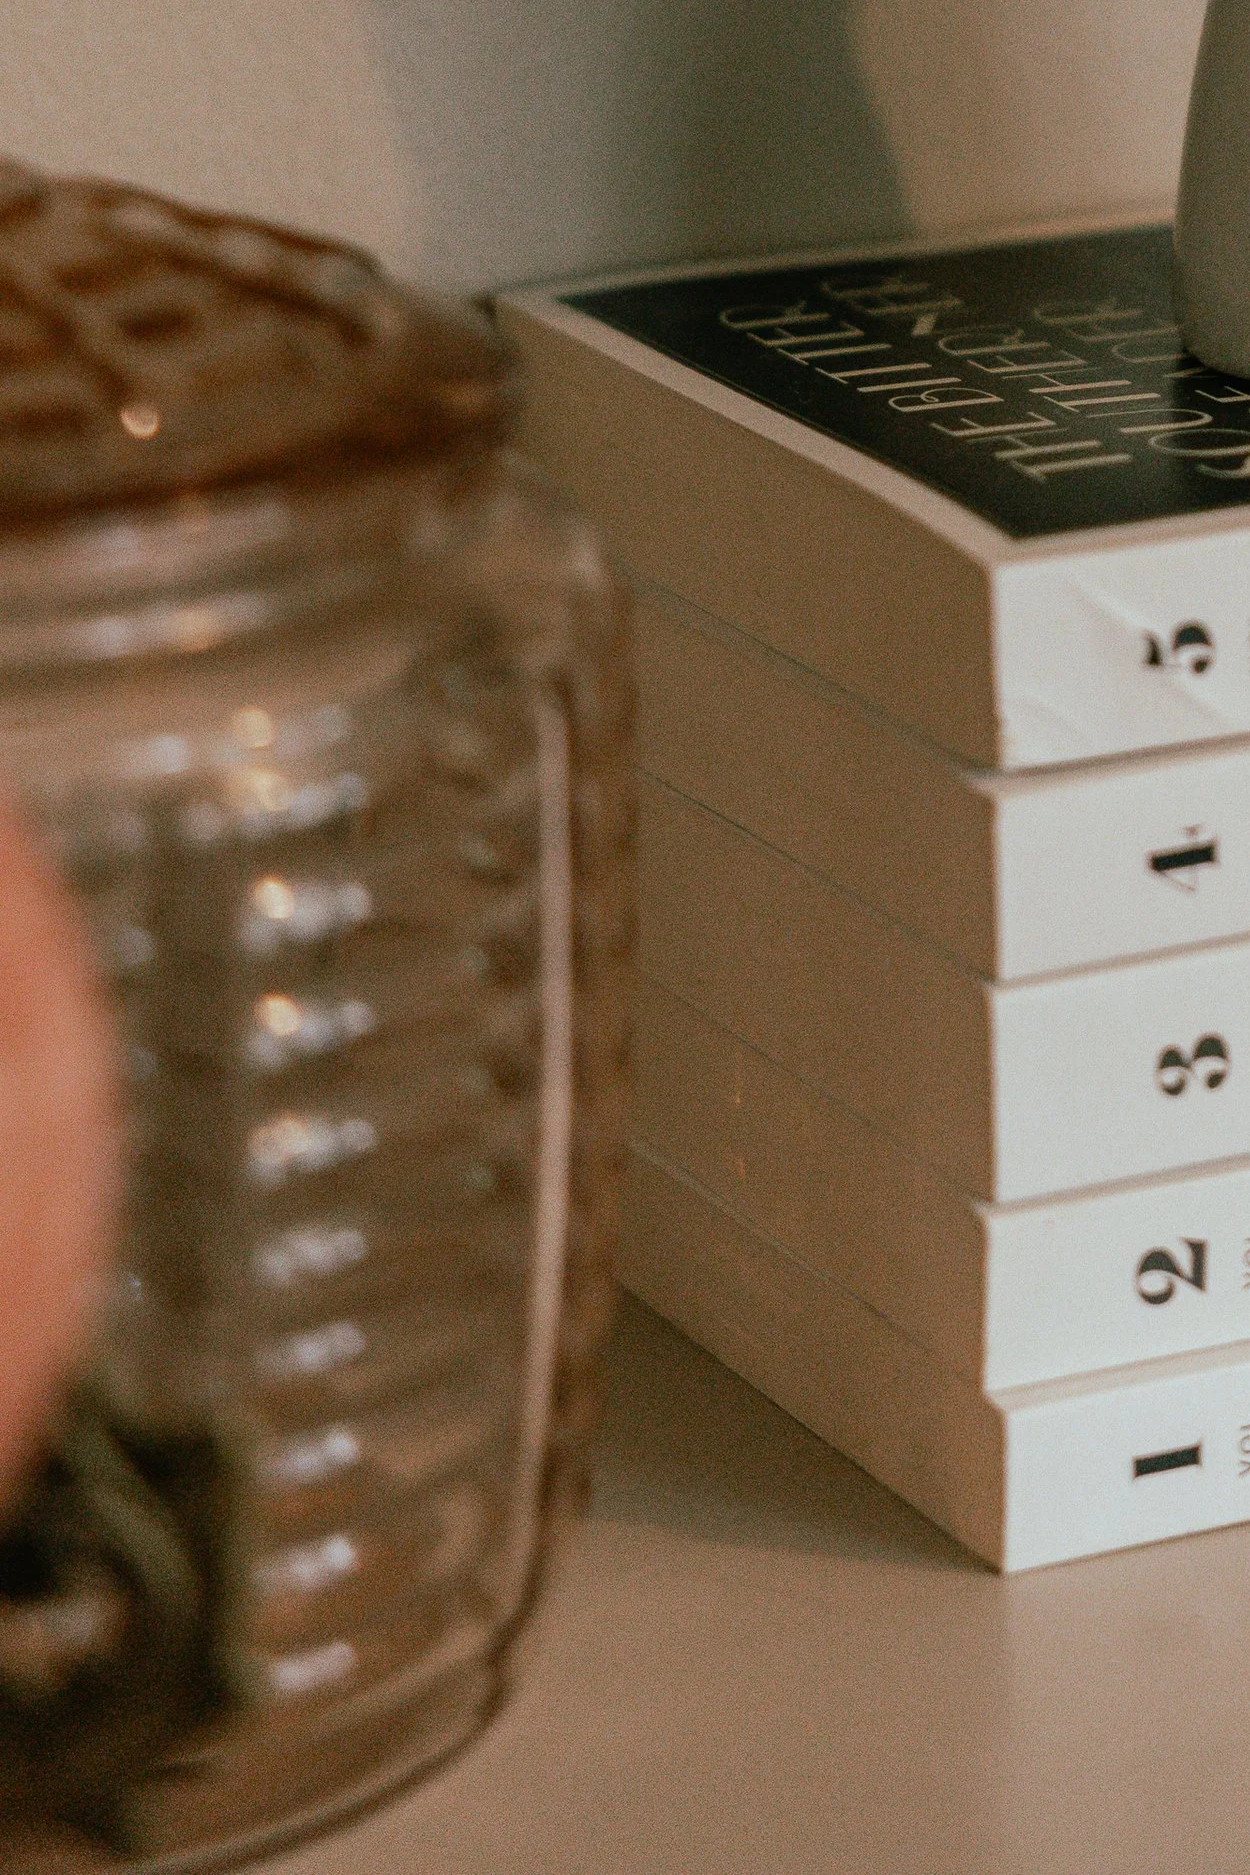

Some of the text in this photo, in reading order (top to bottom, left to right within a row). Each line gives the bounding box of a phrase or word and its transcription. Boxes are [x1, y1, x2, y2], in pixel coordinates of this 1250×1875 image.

[719, 299, 1133, 483] THE BITTER
[1141, 620, 1214, 676] 5
[1147, 824, 1219, 892] 4
[1154, 1032, 1231, 1096] 3
[1134, 1235, 1209, 1305] 2
[1132, 1441, 1202, 1480] 1
